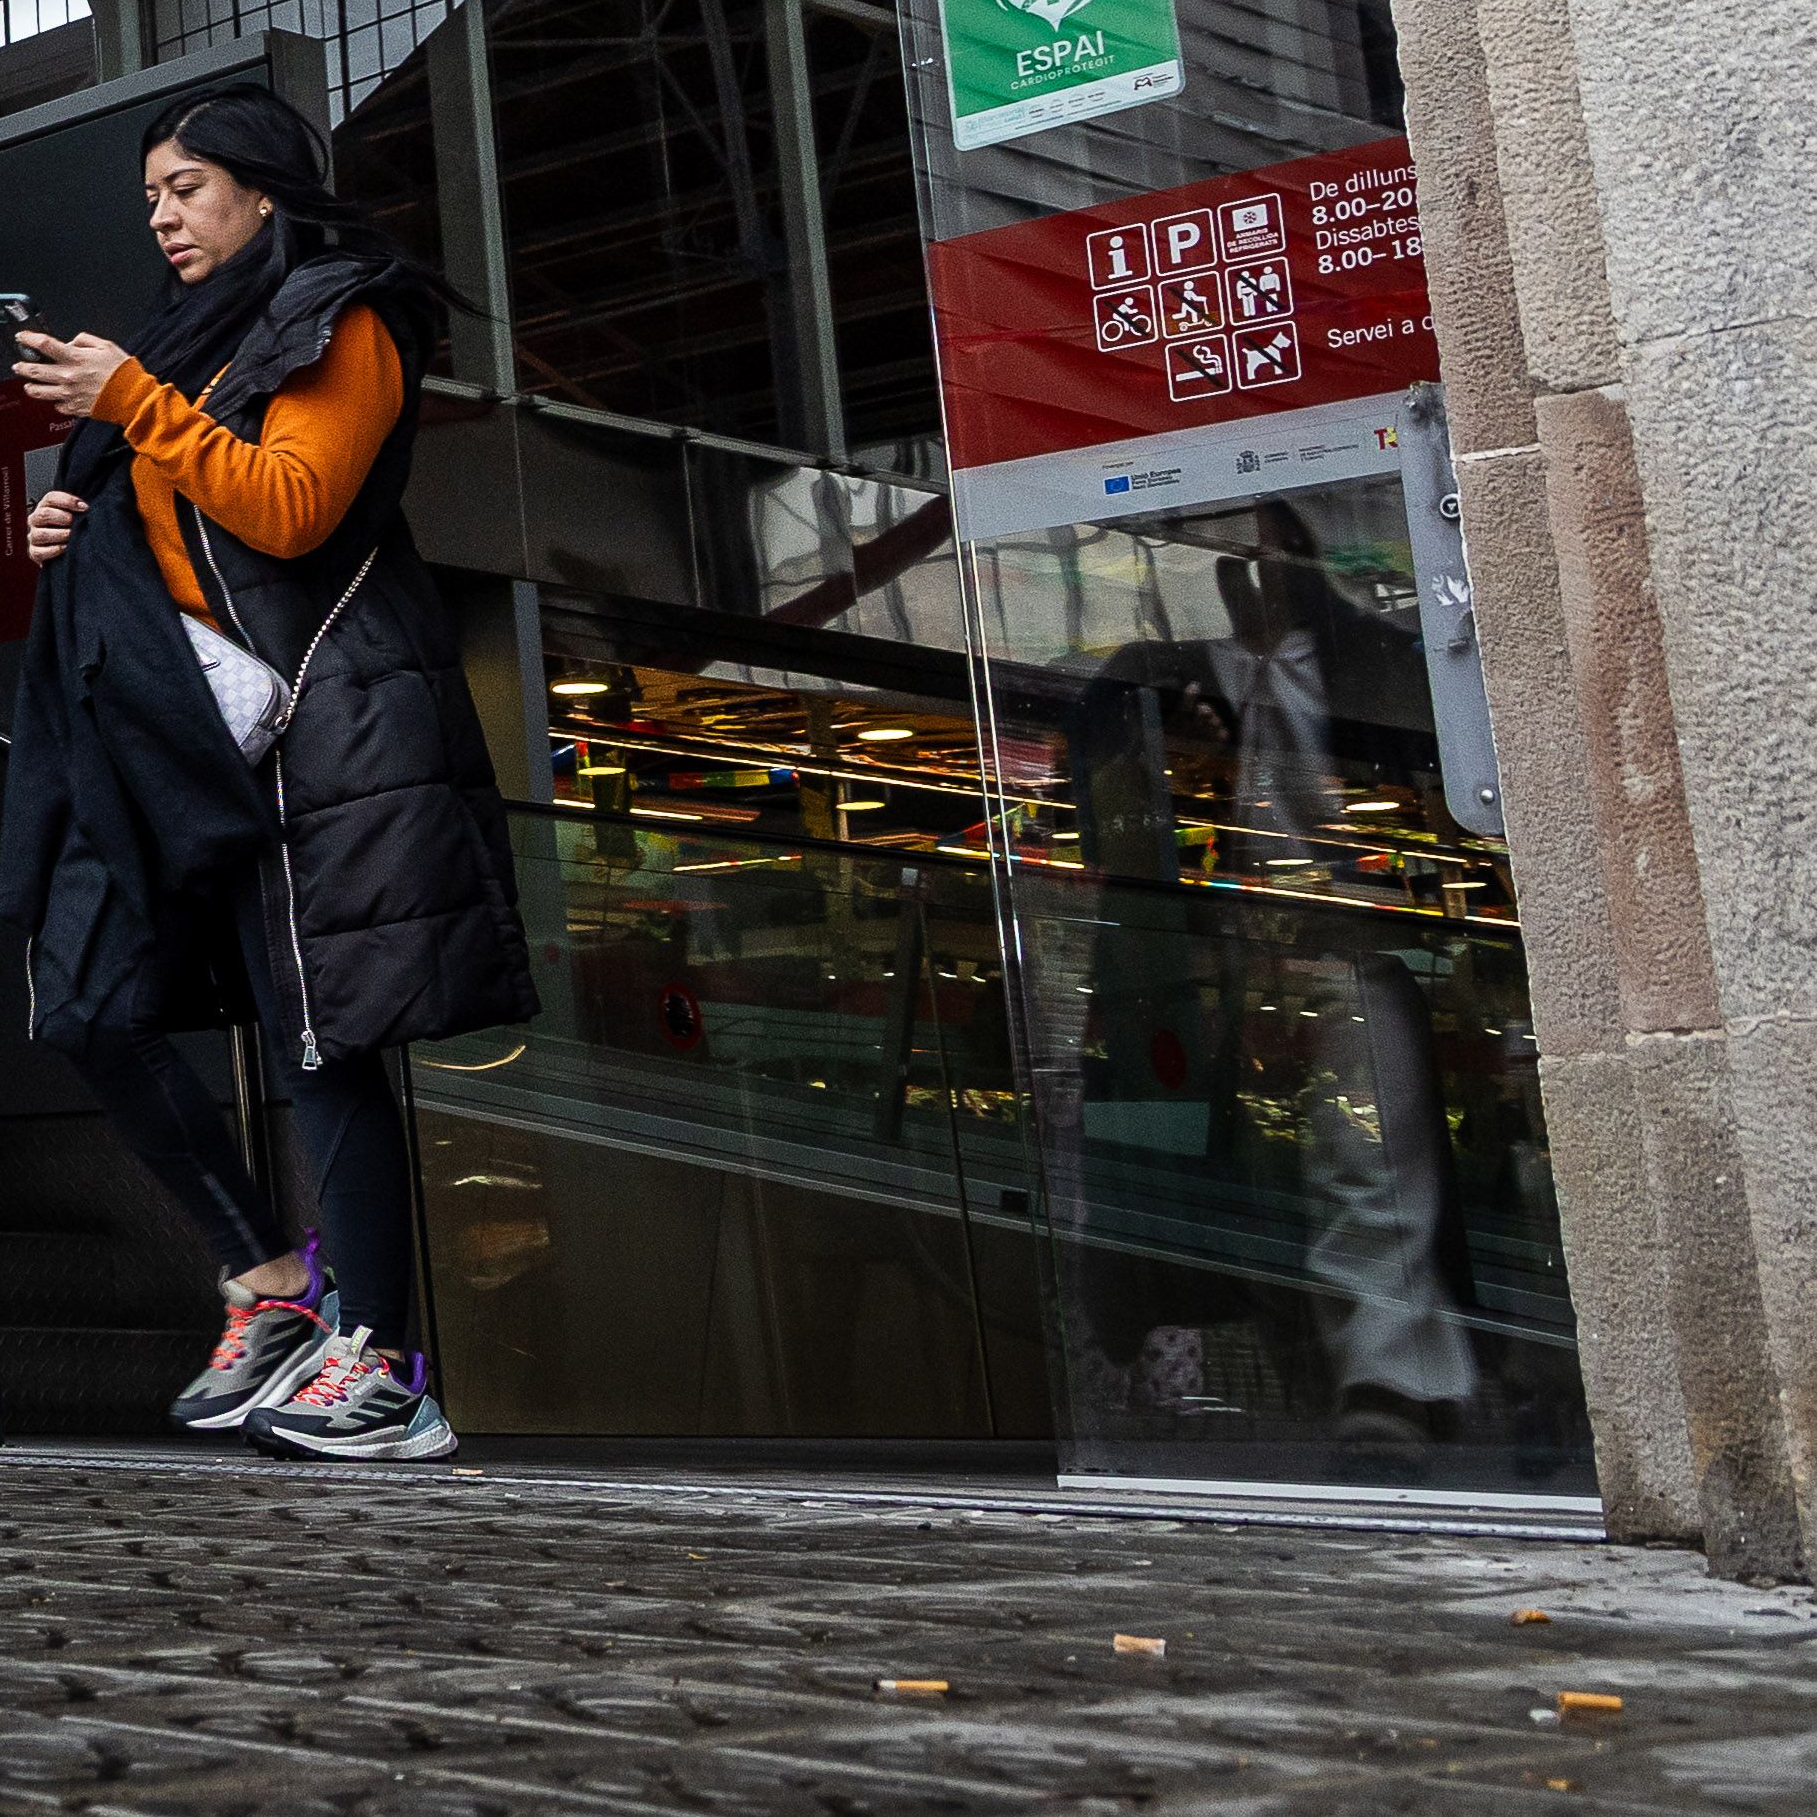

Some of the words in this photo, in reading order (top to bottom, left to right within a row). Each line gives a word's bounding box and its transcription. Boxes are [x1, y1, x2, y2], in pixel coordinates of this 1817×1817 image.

[1016, 30, 1105, 77] ESPAI
[1010, 54, 1116, 91] CARDIOPROTEGIT
[1310, 181, 1339, 201] De
[1345, 164, 1418, 193] dilluns
[1168, 222, 1201, 264] P
[1315, 216, 1420, 250] Dissabtes
[1327, 318, 1393, 348] Servei
[1401, 319, 1415, 335] a
